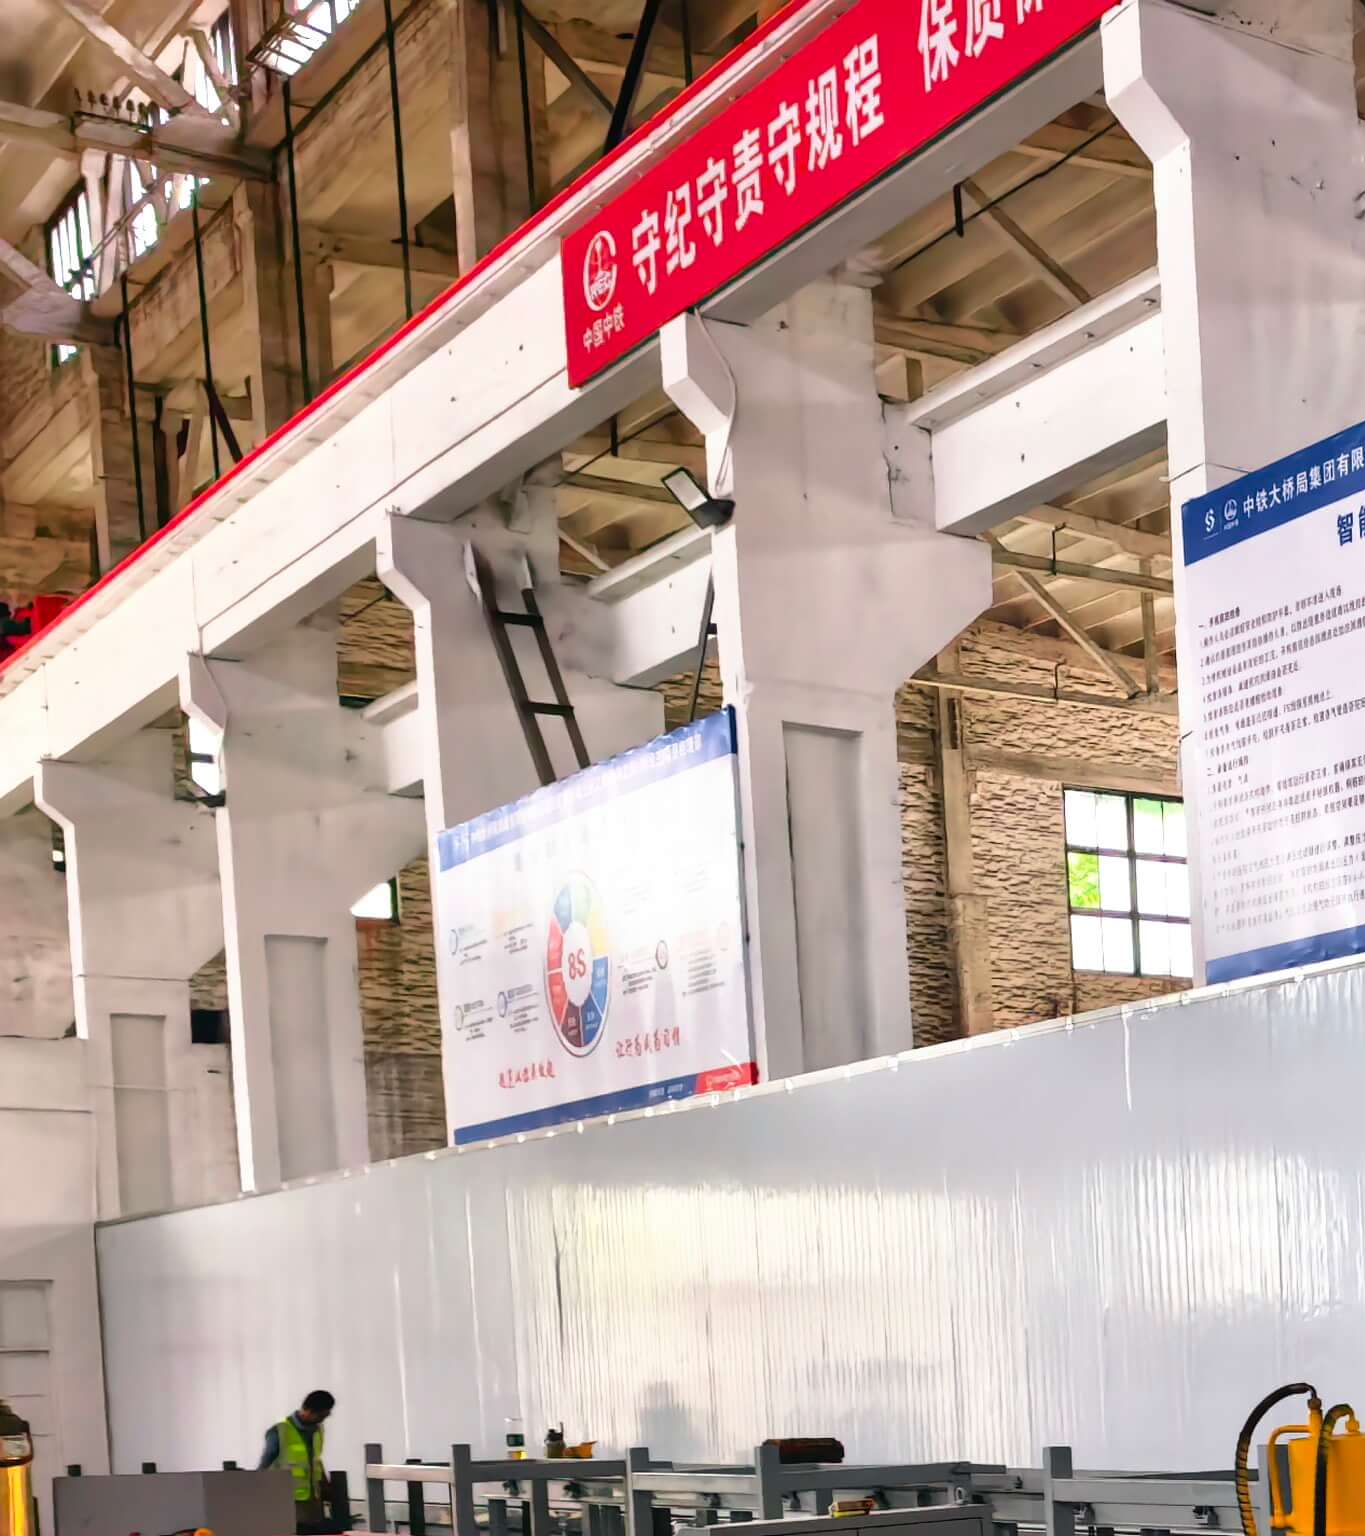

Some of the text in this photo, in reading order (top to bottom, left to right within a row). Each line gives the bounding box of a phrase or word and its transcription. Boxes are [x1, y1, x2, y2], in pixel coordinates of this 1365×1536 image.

[631, 0, 1043, 295] 守纪守责守规程 保质
[568, 950, 586, 979] 8S
